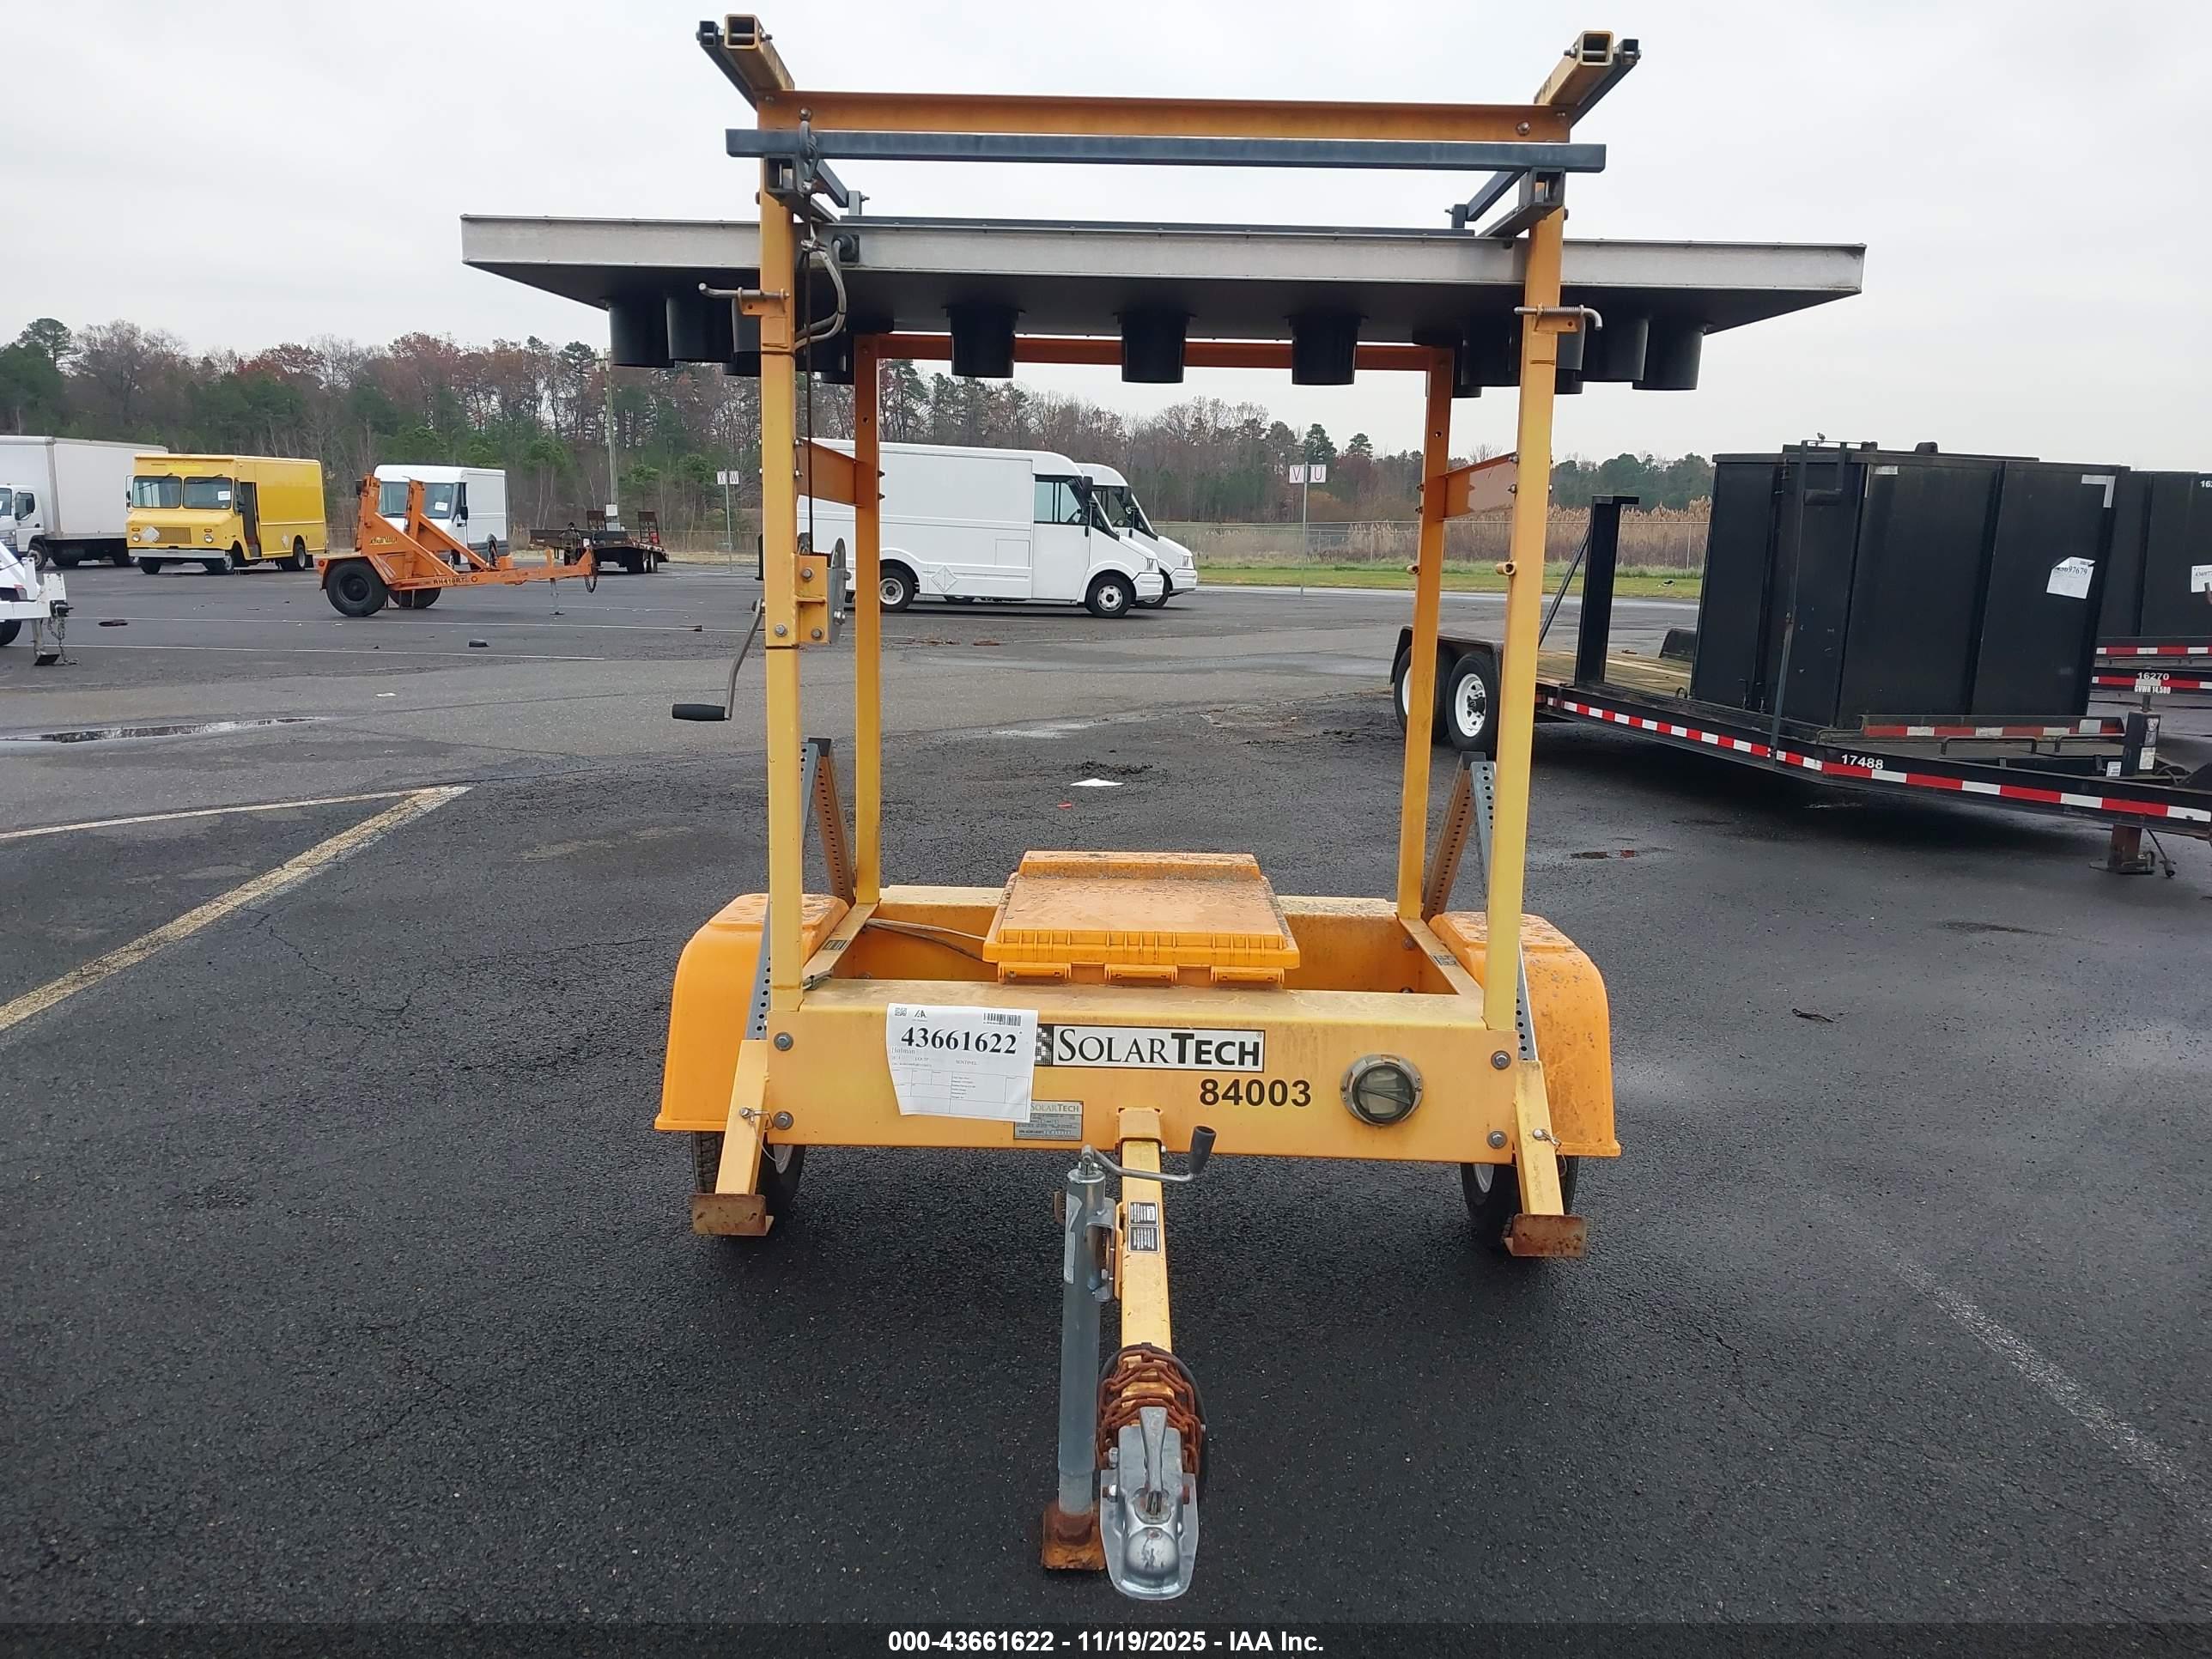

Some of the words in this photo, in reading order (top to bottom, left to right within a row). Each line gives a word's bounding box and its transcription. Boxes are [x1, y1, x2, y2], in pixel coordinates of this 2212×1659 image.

[719, 473, 725, 483] X
[730, 473, 738, 483] W
[1292, 466, 1301, 481] V
[1314, 466, 1322, 481] U
[2136, 672, 2170, 681] 16270
[1841, 754, 1884, 770] 17488
[901, 1026, 1018, 1054] 43661622
[1199, 1079, 1311, 1108] 84003
